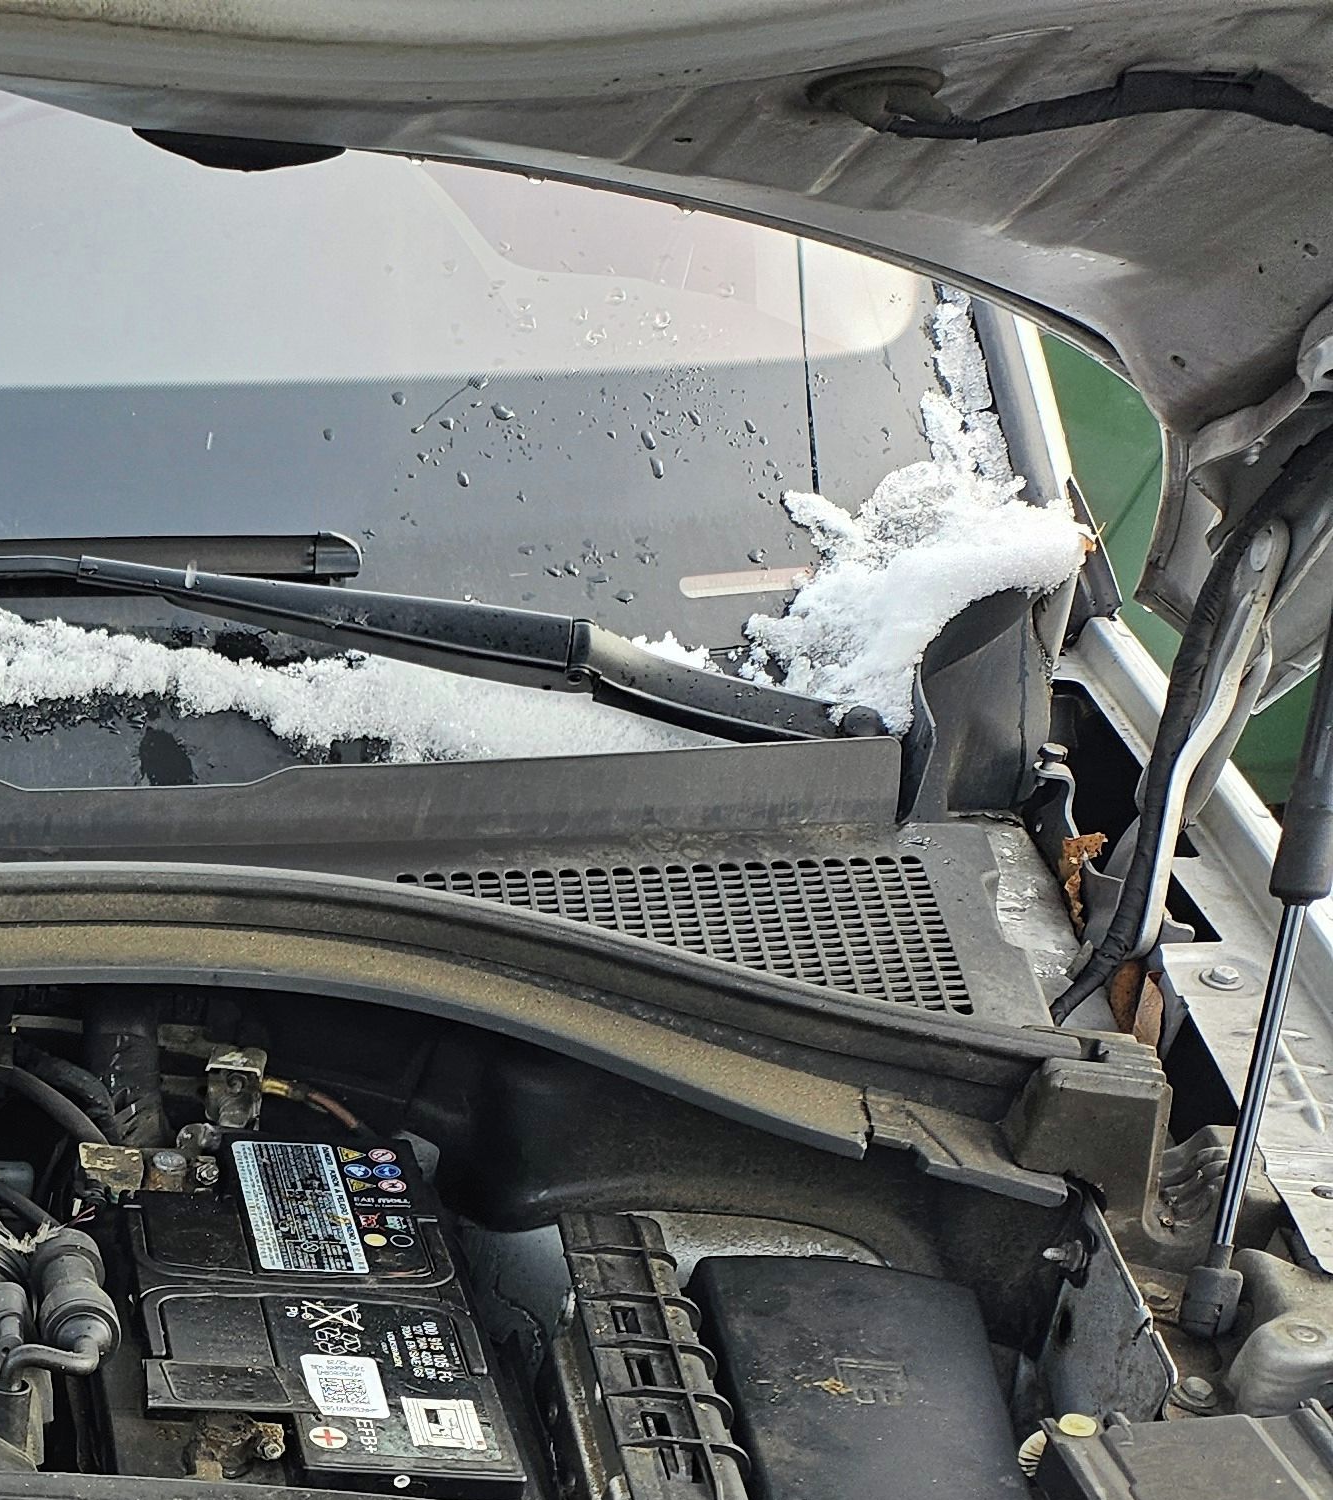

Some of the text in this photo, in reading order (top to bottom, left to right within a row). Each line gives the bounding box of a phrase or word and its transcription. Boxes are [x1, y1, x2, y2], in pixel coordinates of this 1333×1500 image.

[422, 1321, 440, 1336] 000
[433, 1354, 450, 1368] 105
[437, 1370, 454, 1383] FC
[355, 1419, 378, 1454] EFB+
